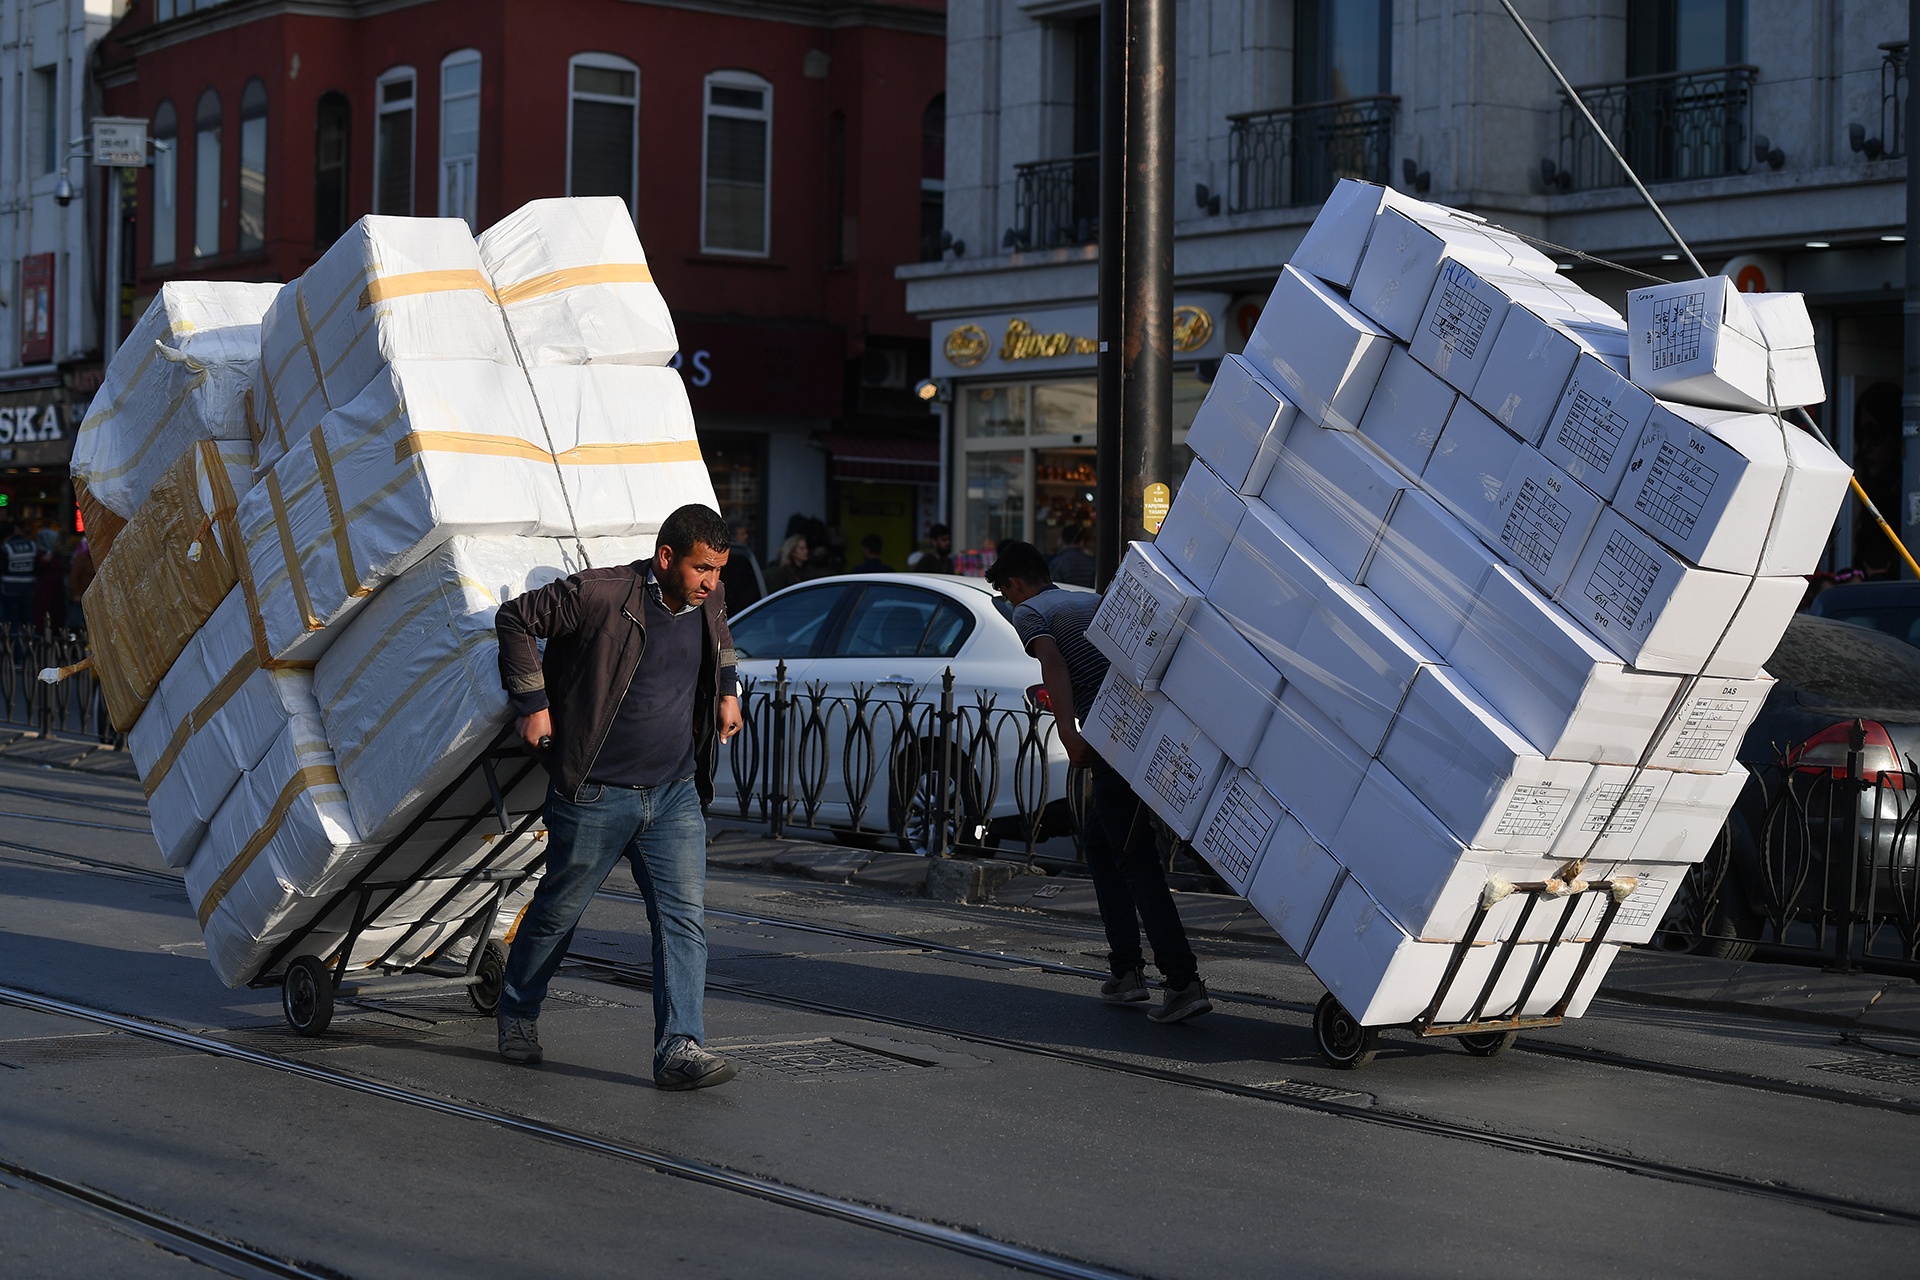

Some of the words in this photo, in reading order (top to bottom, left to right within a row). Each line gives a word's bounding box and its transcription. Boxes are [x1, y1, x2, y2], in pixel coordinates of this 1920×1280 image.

[1688, 438, 1705, 454] DAS
[1546, 477, 1561, 492] DAS
[1594, 612, 1608, 627] DAS
[1144, 629, 1157, 646] DAS
[1721, 687, 1737, 695] DAS
